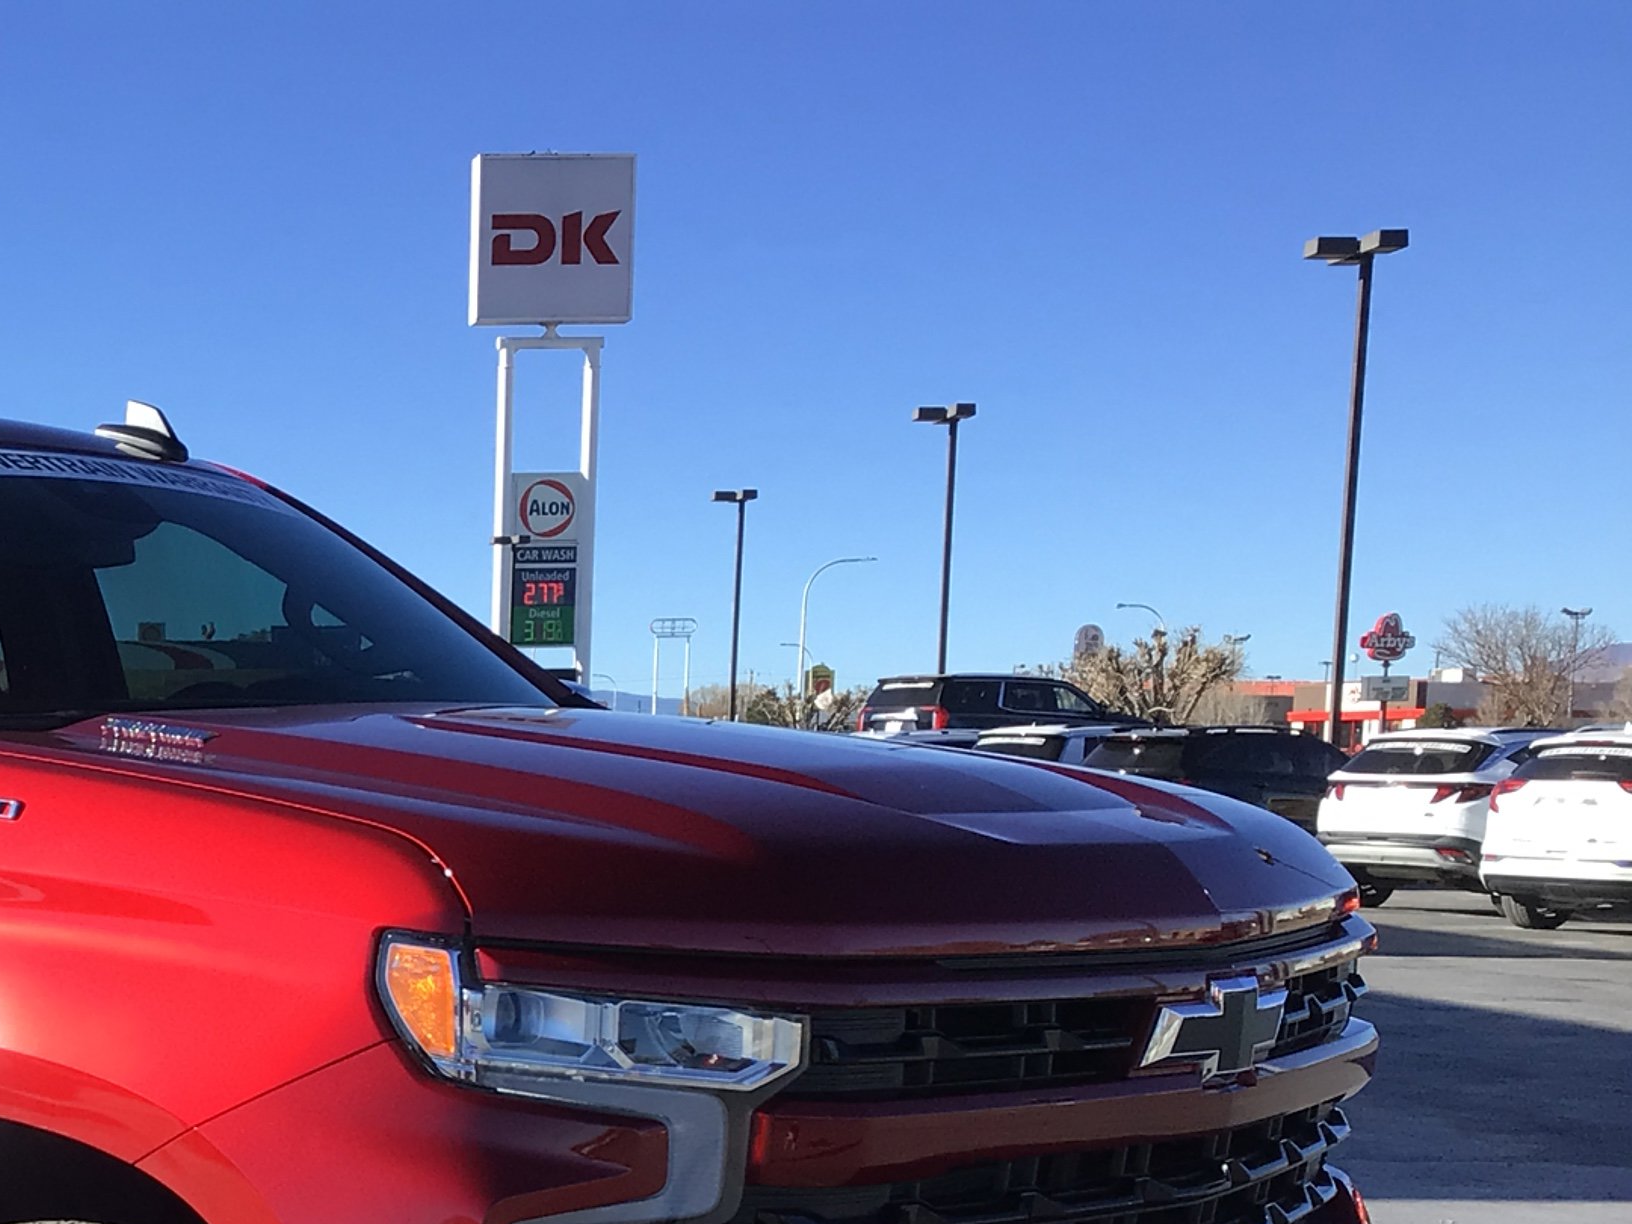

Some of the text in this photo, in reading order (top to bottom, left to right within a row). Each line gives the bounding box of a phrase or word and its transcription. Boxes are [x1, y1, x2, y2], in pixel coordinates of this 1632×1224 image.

[491, 209, 622, 266] DK
[517, 549, 575, 561] CAR WASH
[521, 571, 570, 581] Unleaded
[529, 608, 561, 619] Diesel
